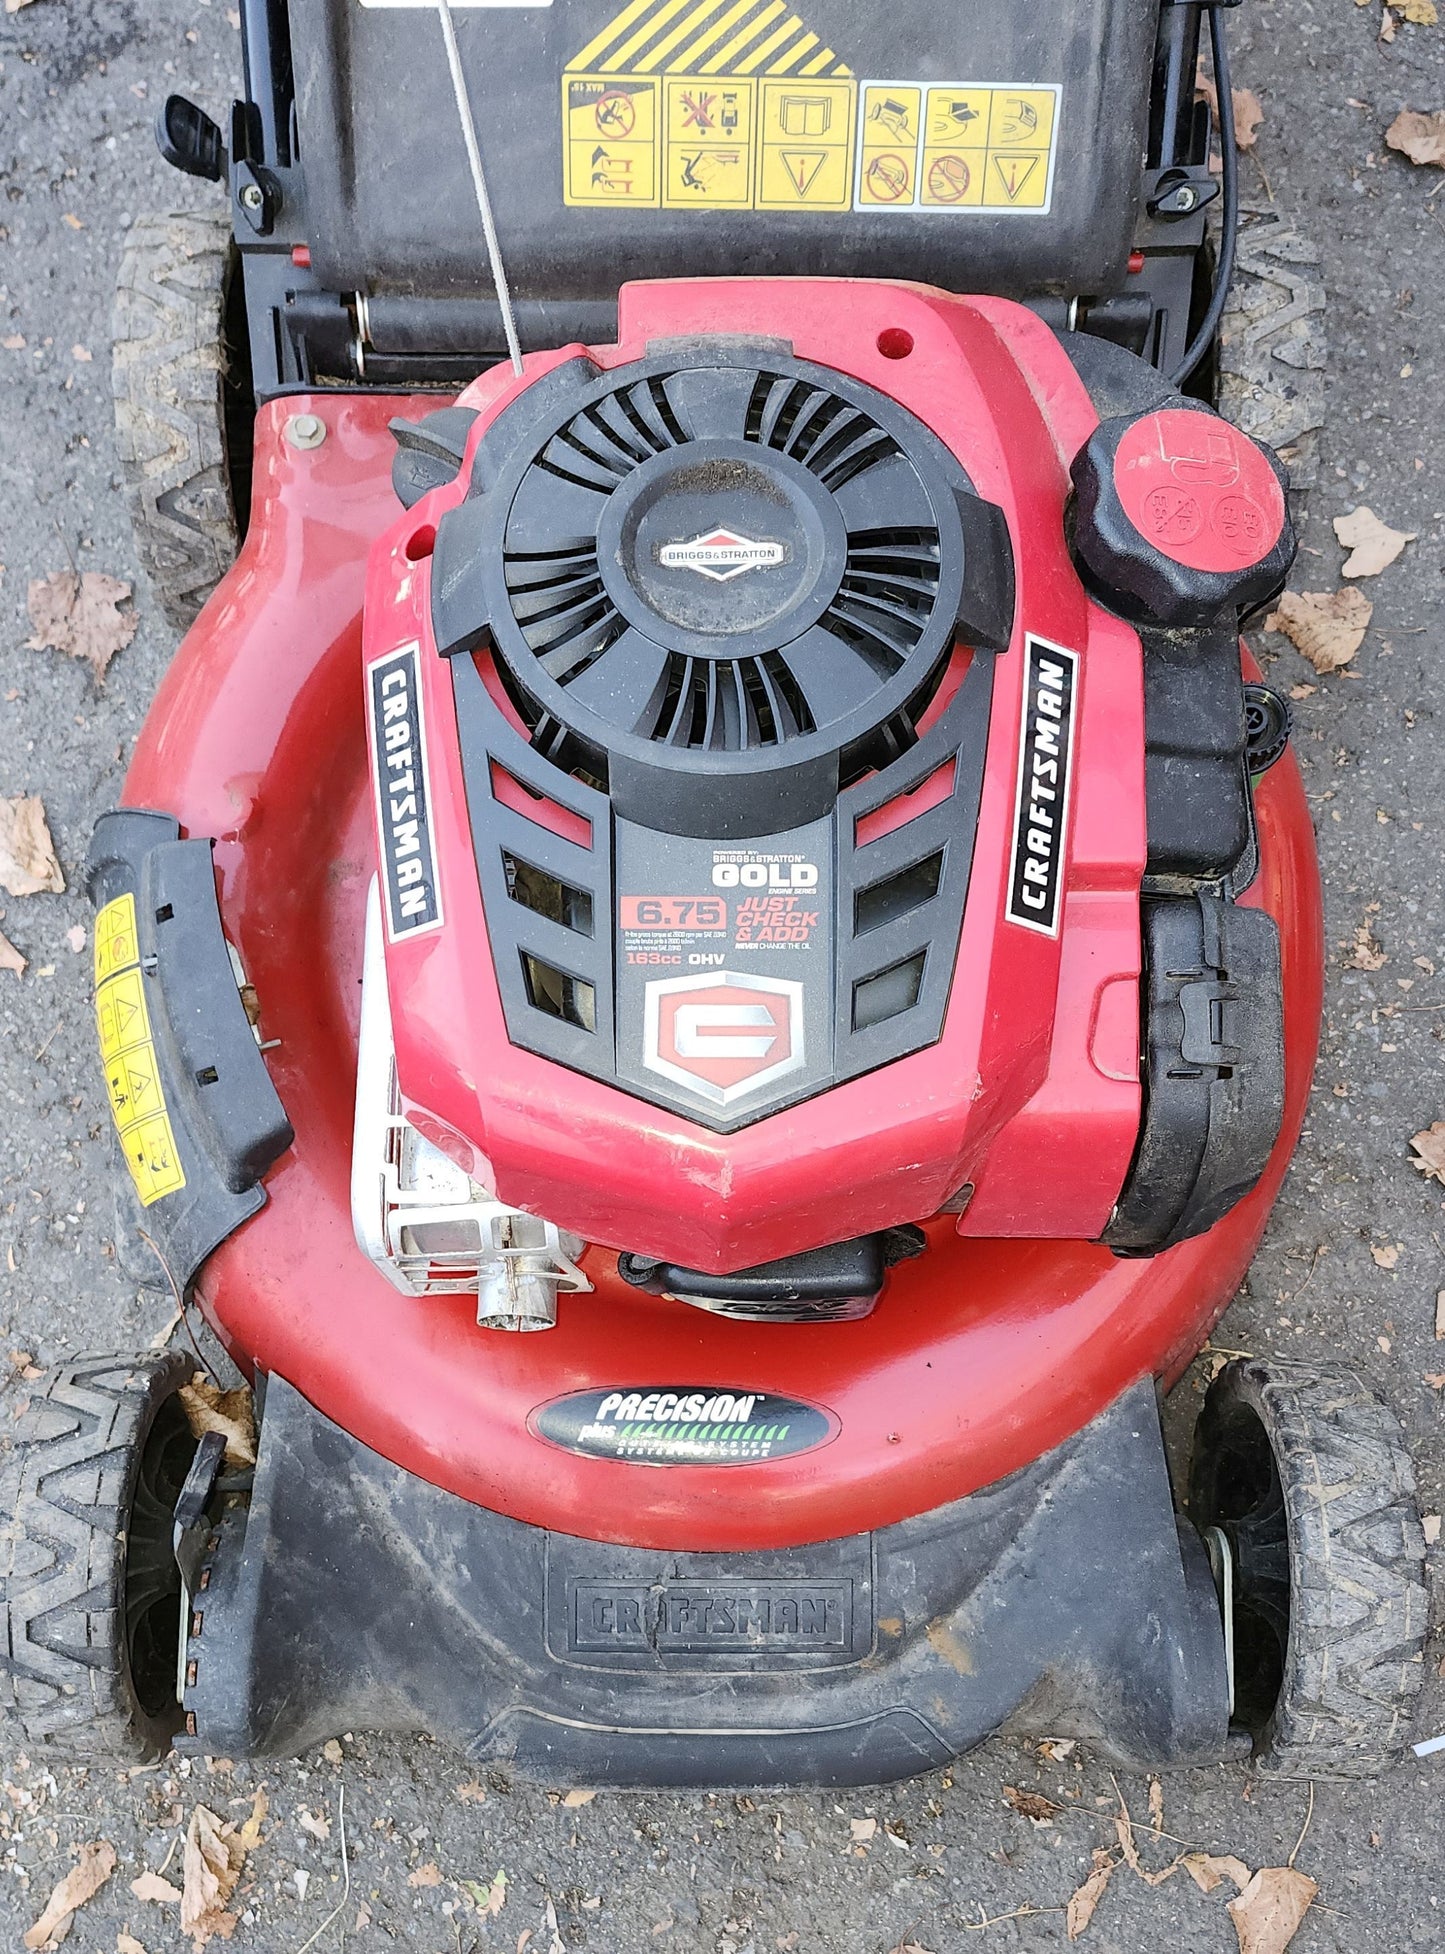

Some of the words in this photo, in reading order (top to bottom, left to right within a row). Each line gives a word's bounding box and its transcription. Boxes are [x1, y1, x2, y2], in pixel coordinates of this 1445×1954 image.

[668, 549, 776, 561] BRIGGS&STRATTON
[1021, 658, 1065, 911] CRAFTSMAN
[381, 668, 428, 918] CRAFTSMAN
[712, 863, 819, 888] GOLD
[736, 896, 799, 912] JUST
[636, 900, 720, 925] 6.75
[735, 911, 820, 927] CHECK
[735, 926, 752, 942] &
[755, 926, 810, 942] ADD
[759, 942, 786, 950] CHANGE
[787, 942, 800, 950] THE
[627, 952, 682, 965] 163cc
[688, 953, 725, 965] OHV
[577, 1422, 617, 1442] plus
[719, 1448, 770, 1457] COUPE
